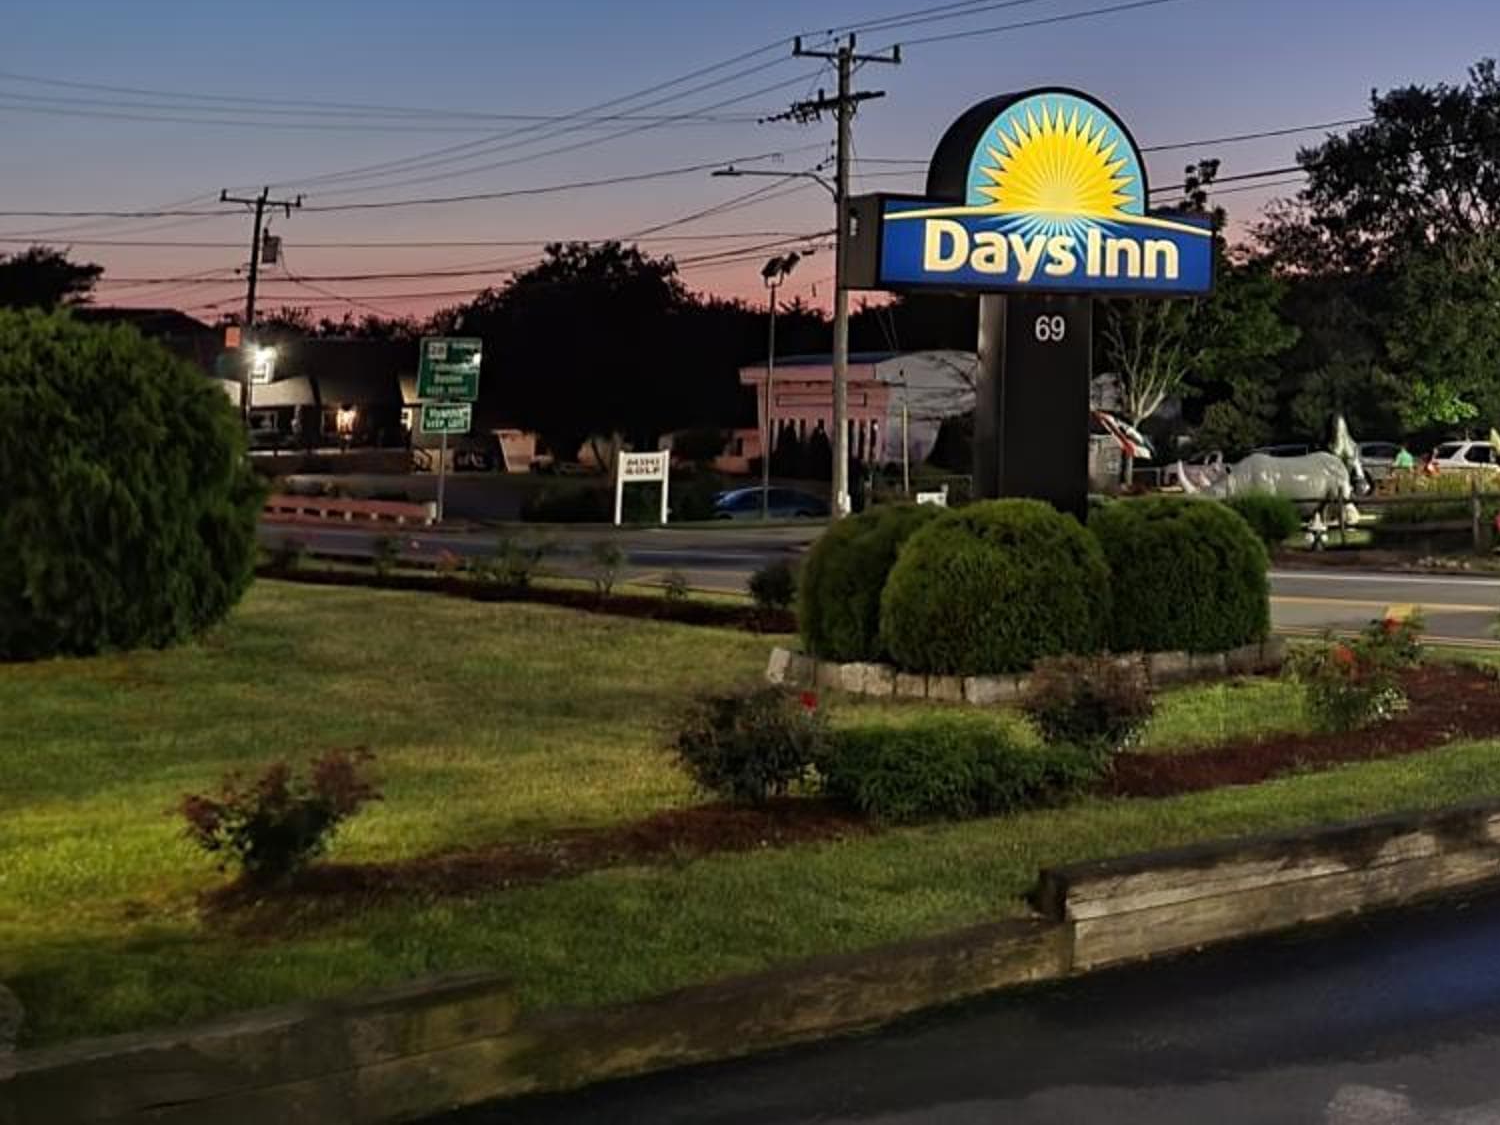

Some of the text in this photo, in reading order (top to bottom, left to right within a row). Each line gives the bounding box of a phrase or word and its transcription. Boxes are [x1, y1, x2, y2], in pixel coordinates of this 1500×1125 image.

[924, 218, 1180, 282] Days Inn
[1034, 315, 1065, 342] 69
